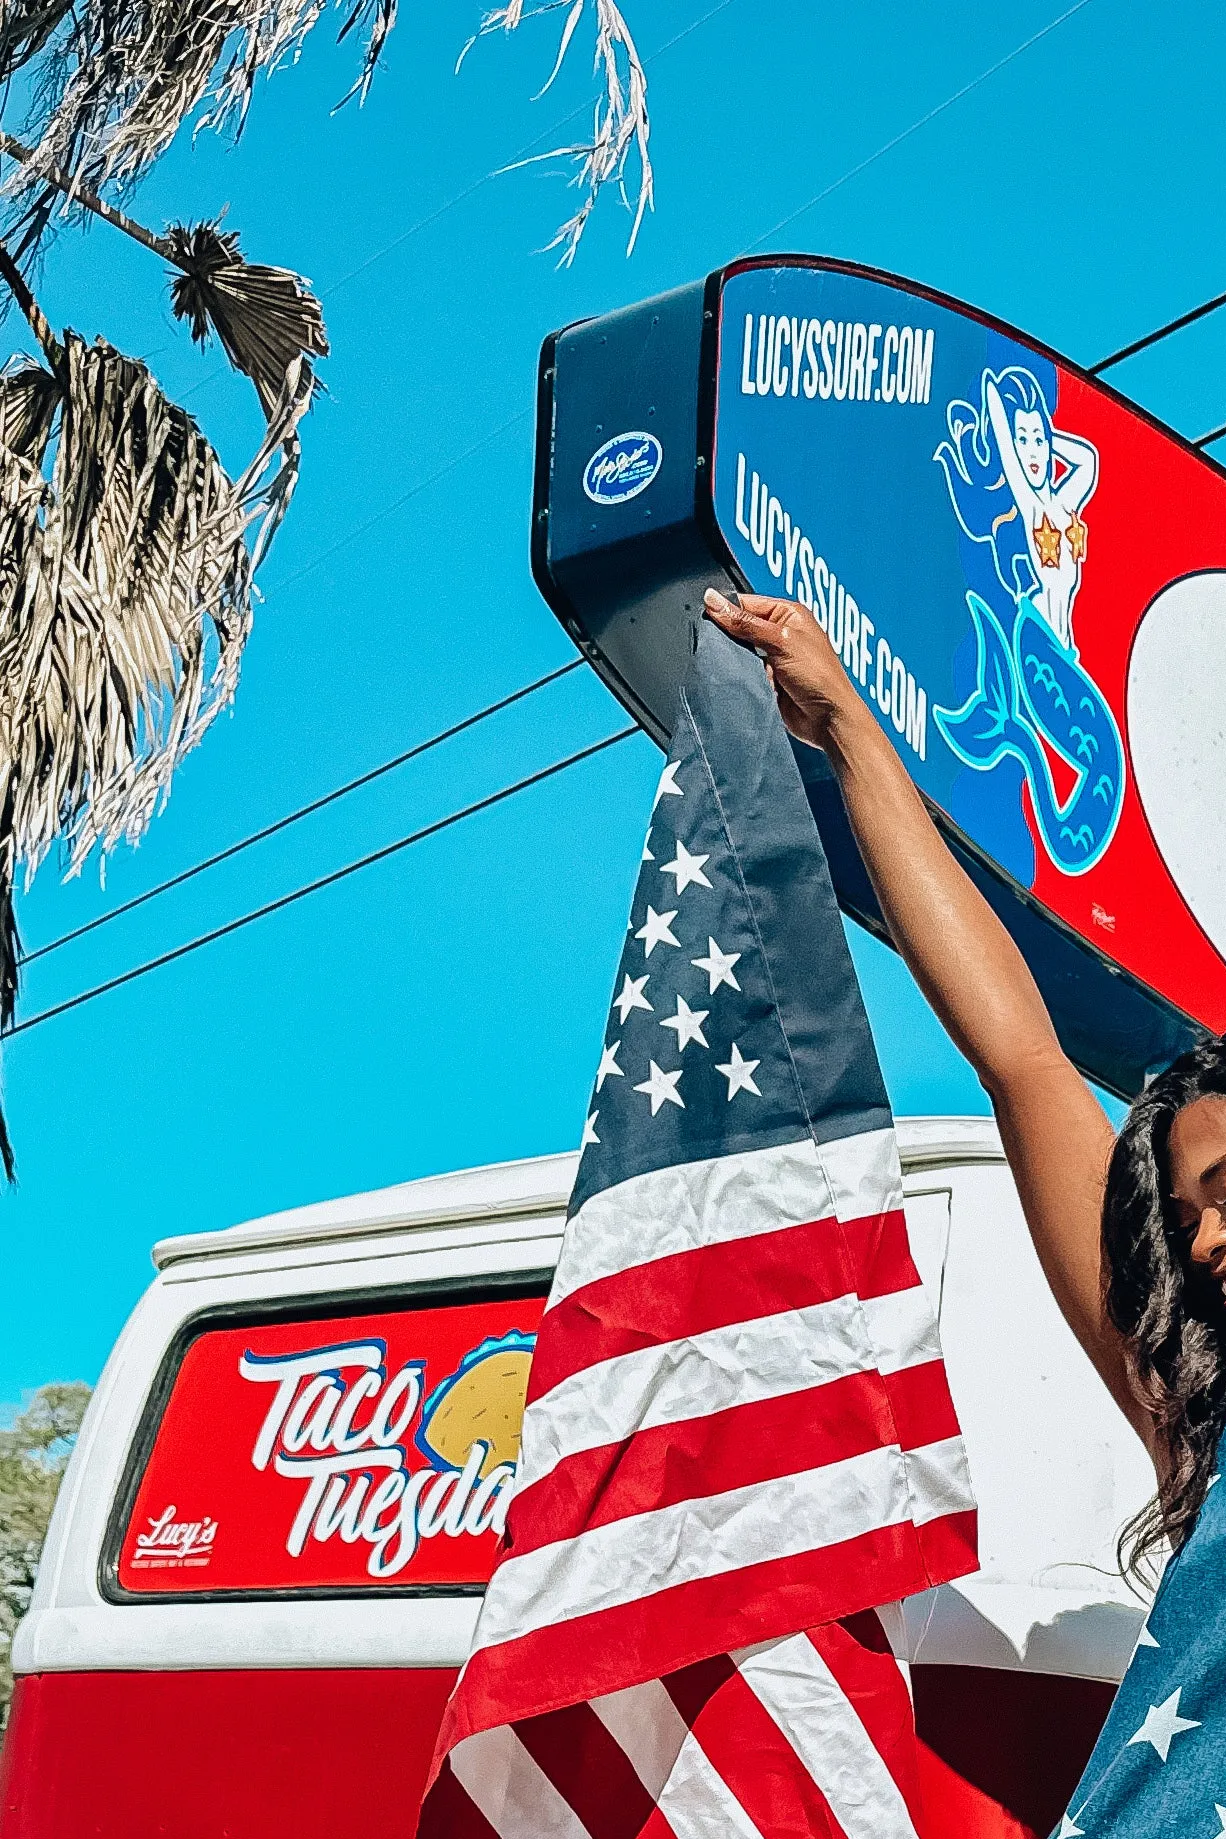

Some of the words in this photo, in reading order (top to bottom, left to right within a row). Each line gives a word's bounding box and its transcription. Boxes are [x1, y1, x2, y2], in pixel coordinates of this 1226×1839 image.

[741, 313, 934, 404] LUCYSSURF.COM
[735, 452, 928, 762] LUCYSSURF.COM
[239, 1338, 426, 1471] Taco
[137, 1504, 219, 1559] Lucy's
[274, 1440, 518, 1578] Tuesda
